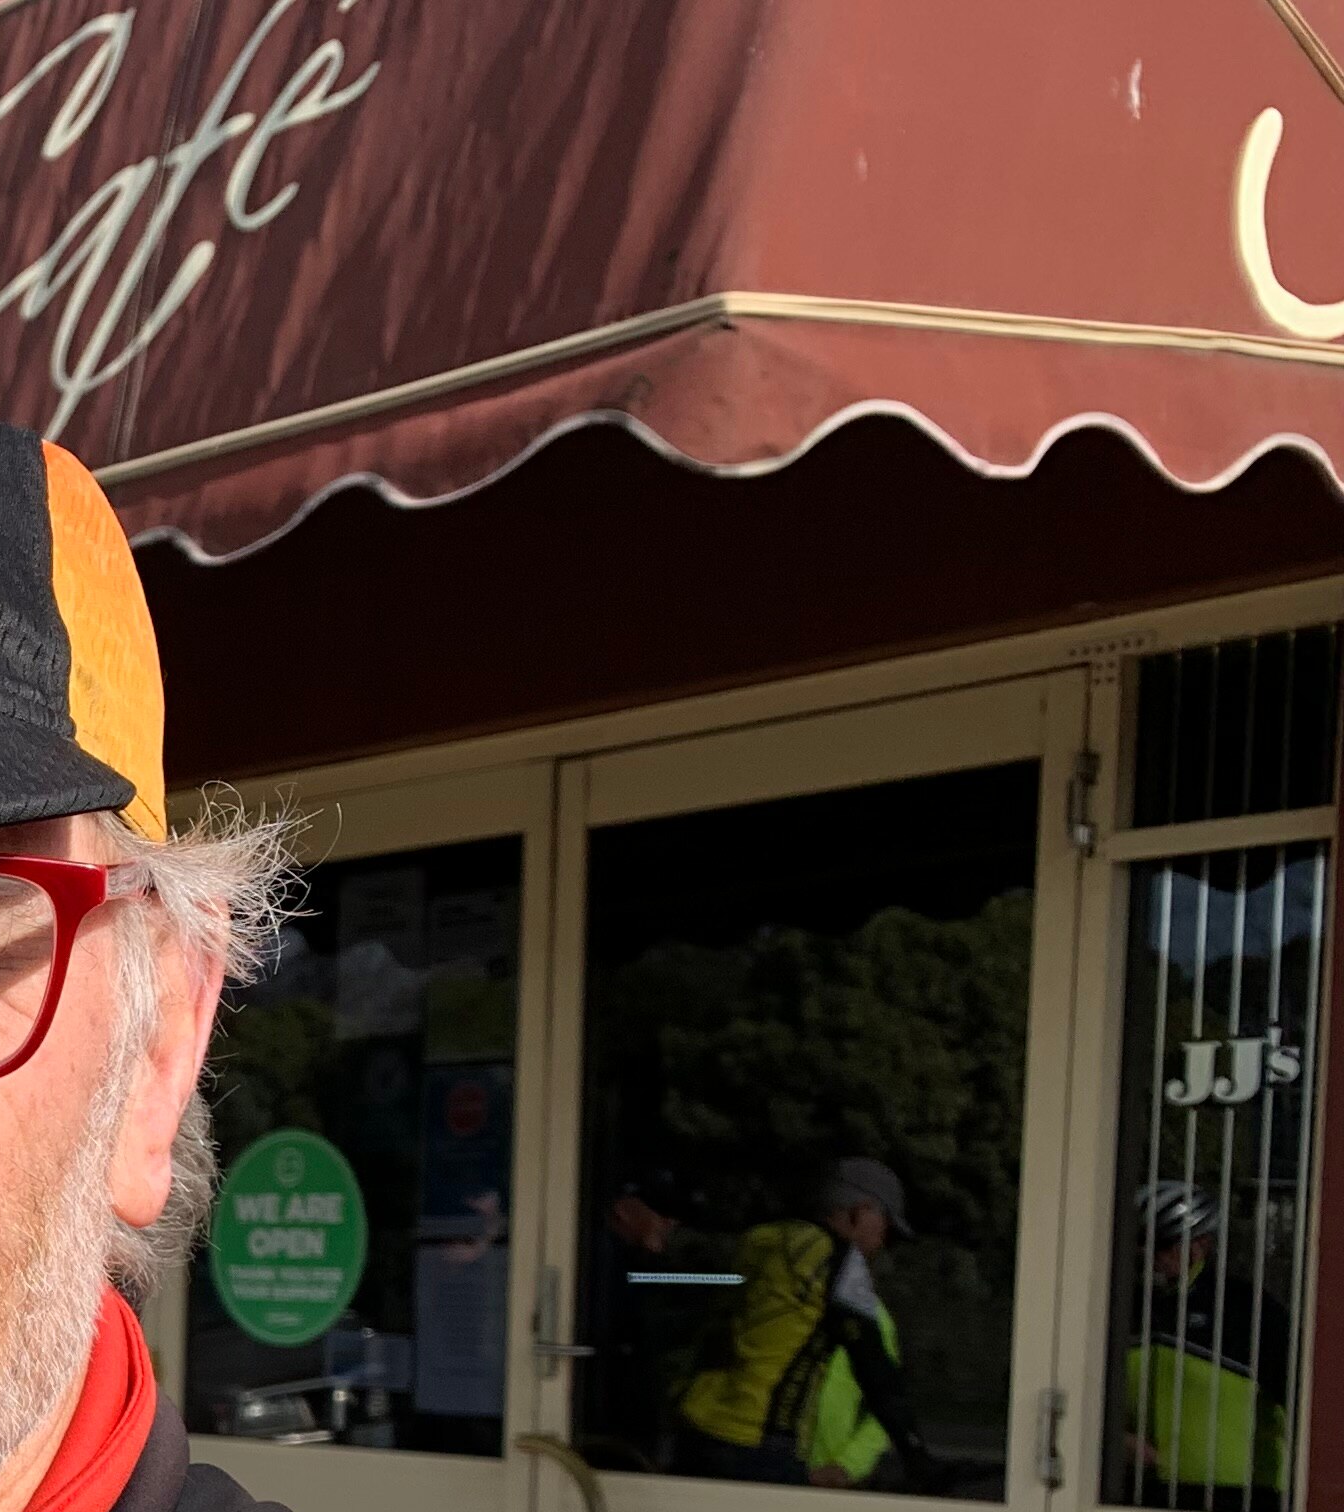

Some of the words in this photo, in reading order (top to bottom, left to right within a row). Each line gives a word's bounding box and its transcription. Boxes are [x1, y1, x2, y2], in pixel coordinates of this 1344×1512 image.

[234, 1193, 280, 1224] WE
[286, 1193, 344, 1225] ARE
[248, 1227, 326, 1259] OPEN
